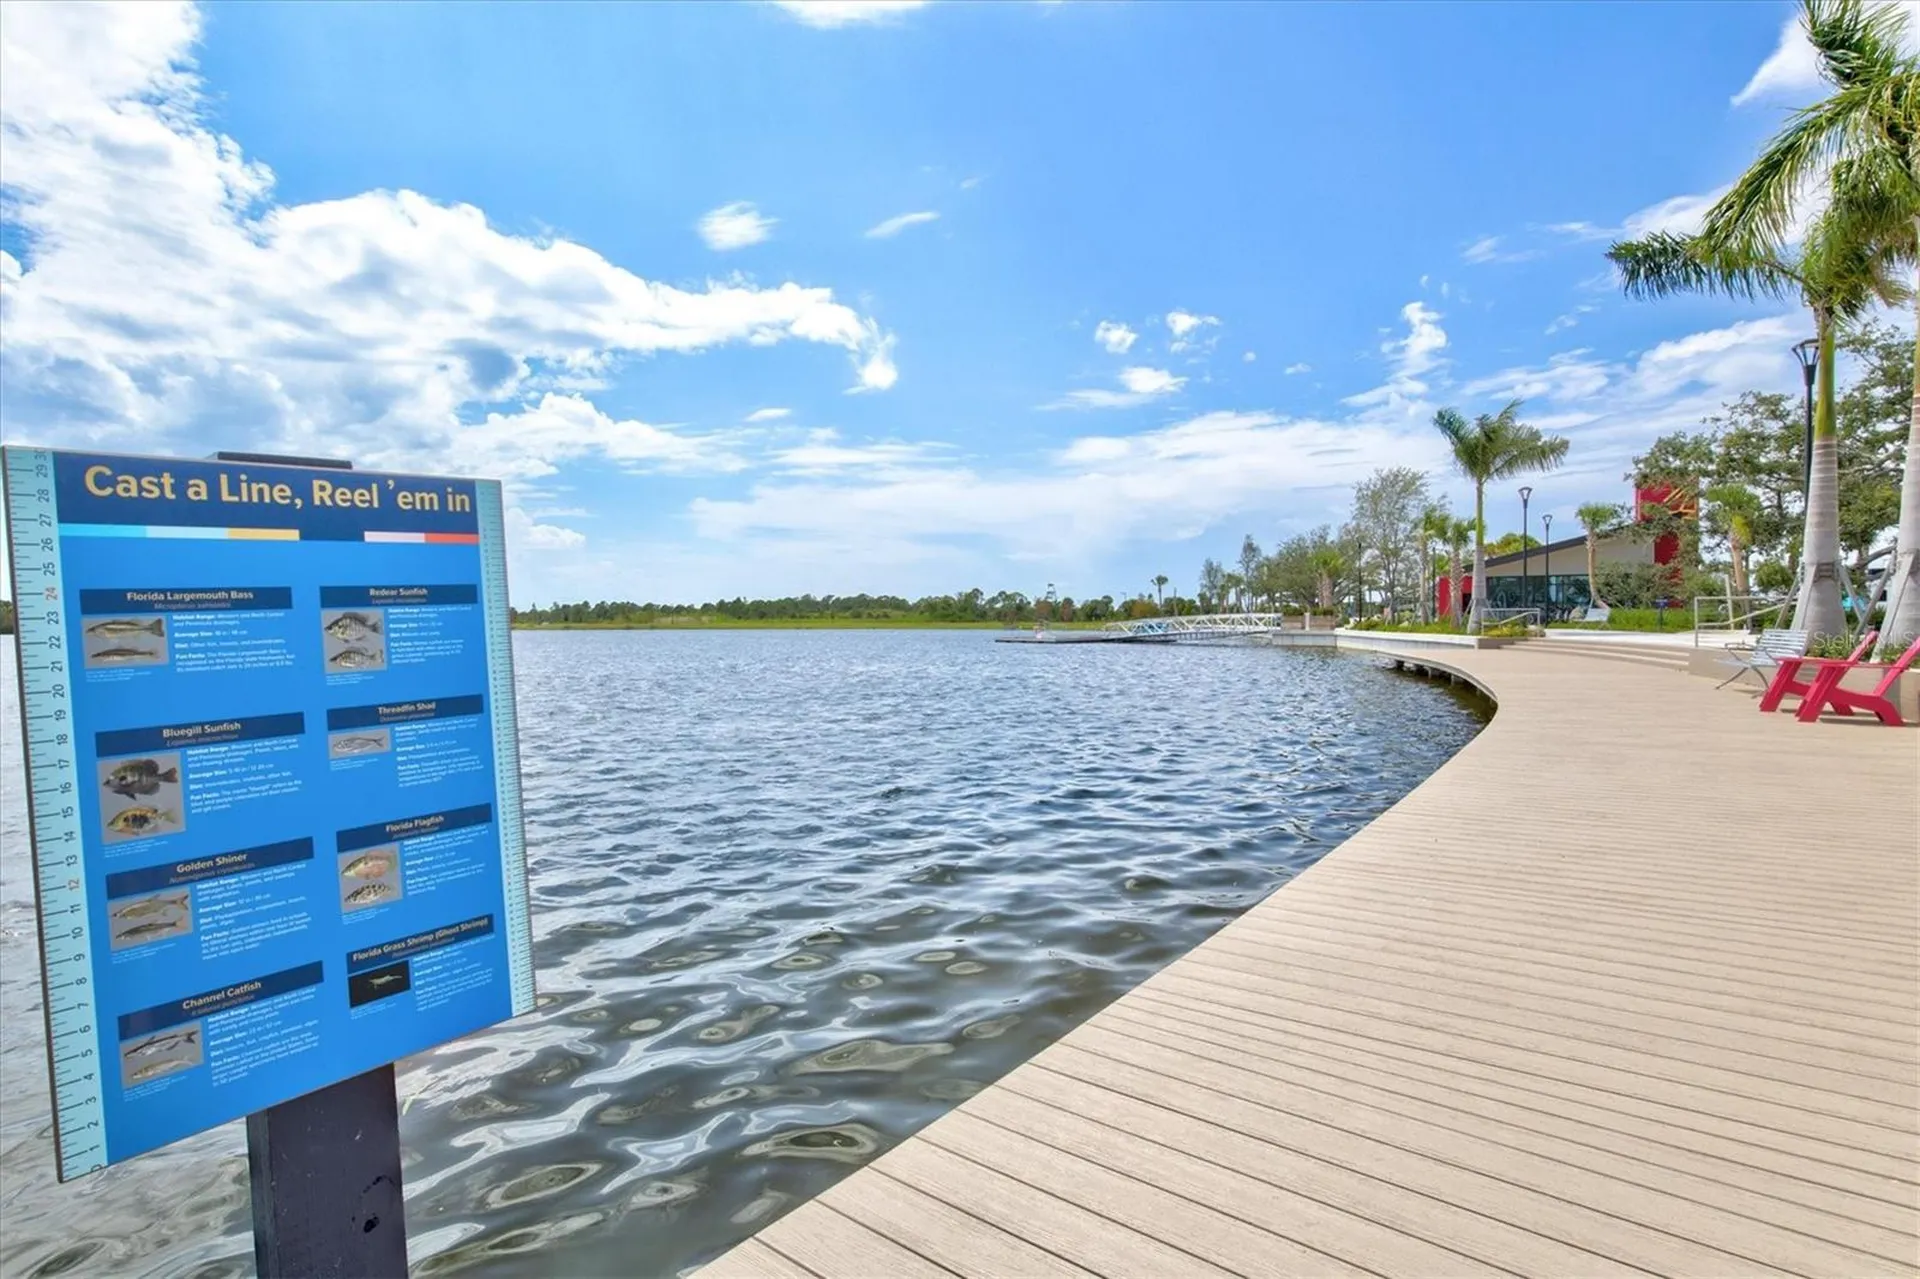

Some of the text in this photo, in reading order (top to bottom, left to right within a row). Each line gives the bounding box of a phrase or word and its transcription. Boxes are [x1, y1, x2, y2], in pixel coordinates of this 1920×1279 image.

[36, 464, 48, 478] 29
[84, 465, 175, 499] Cast
[186, 478, 208, 500] a
[220, 473, 303, 510] Line,
[312, 479, 378, 508] Reel
[447, 488, 470, 512] in
[38, 489, 50, 503] 28
[40, 514, 52, 527] 27
[42, 537, 54, 551] 26
[44, 562, 56, 576] 25
[46, 586, 58, 600] 24
[127, 592, 164, 600] Florida
[167, 591, 228, 601] Largemouth
[48, 610, 59, 625] 23
[50, 635, 60, 649] 22
[51, 660, 62, 672] 21
[53, 684, 64, 699] 20
[378, 702, 436, 714] Threadfin Shad
[55, 708, 66, 721] 19
[163, 722, 241, 738] Bluegill Sunfish
[56, 734, 68, 745] 18
[58, 758, 70, 770] 17
[60, 782, 72, 794] 16
[62, 806, 73, 818] 15
[386, 816, 444, 832] Florida Flagfish
[64, 830, 75, 842] 14
[66, 854, 77, 866] 13
[177, 853, 247, 873] Golden Shiner
[68, 878, 80, 890] 12
[70, 904, 81, 913] 11
[72, 926, 84, 940] 10
[353, 948, 381, 961] Florida
[383, 942, 406, 952] Grass
[407, 934, 434, 946] Shrimp
[74, 953, 85, 961] 9
[76, 976, 87, 985] 8
[182, 990, 225, 1009] Channel
[227, 981, 261, 997] Catfish
[80, 1024, 91, 1033] 6
[82, 1049, 92, 1057] 5
[84, 1073, 95, 1081] 4
[86, 1096, 96, 1105] 3
[88, 1120, 99, 1129] 2
